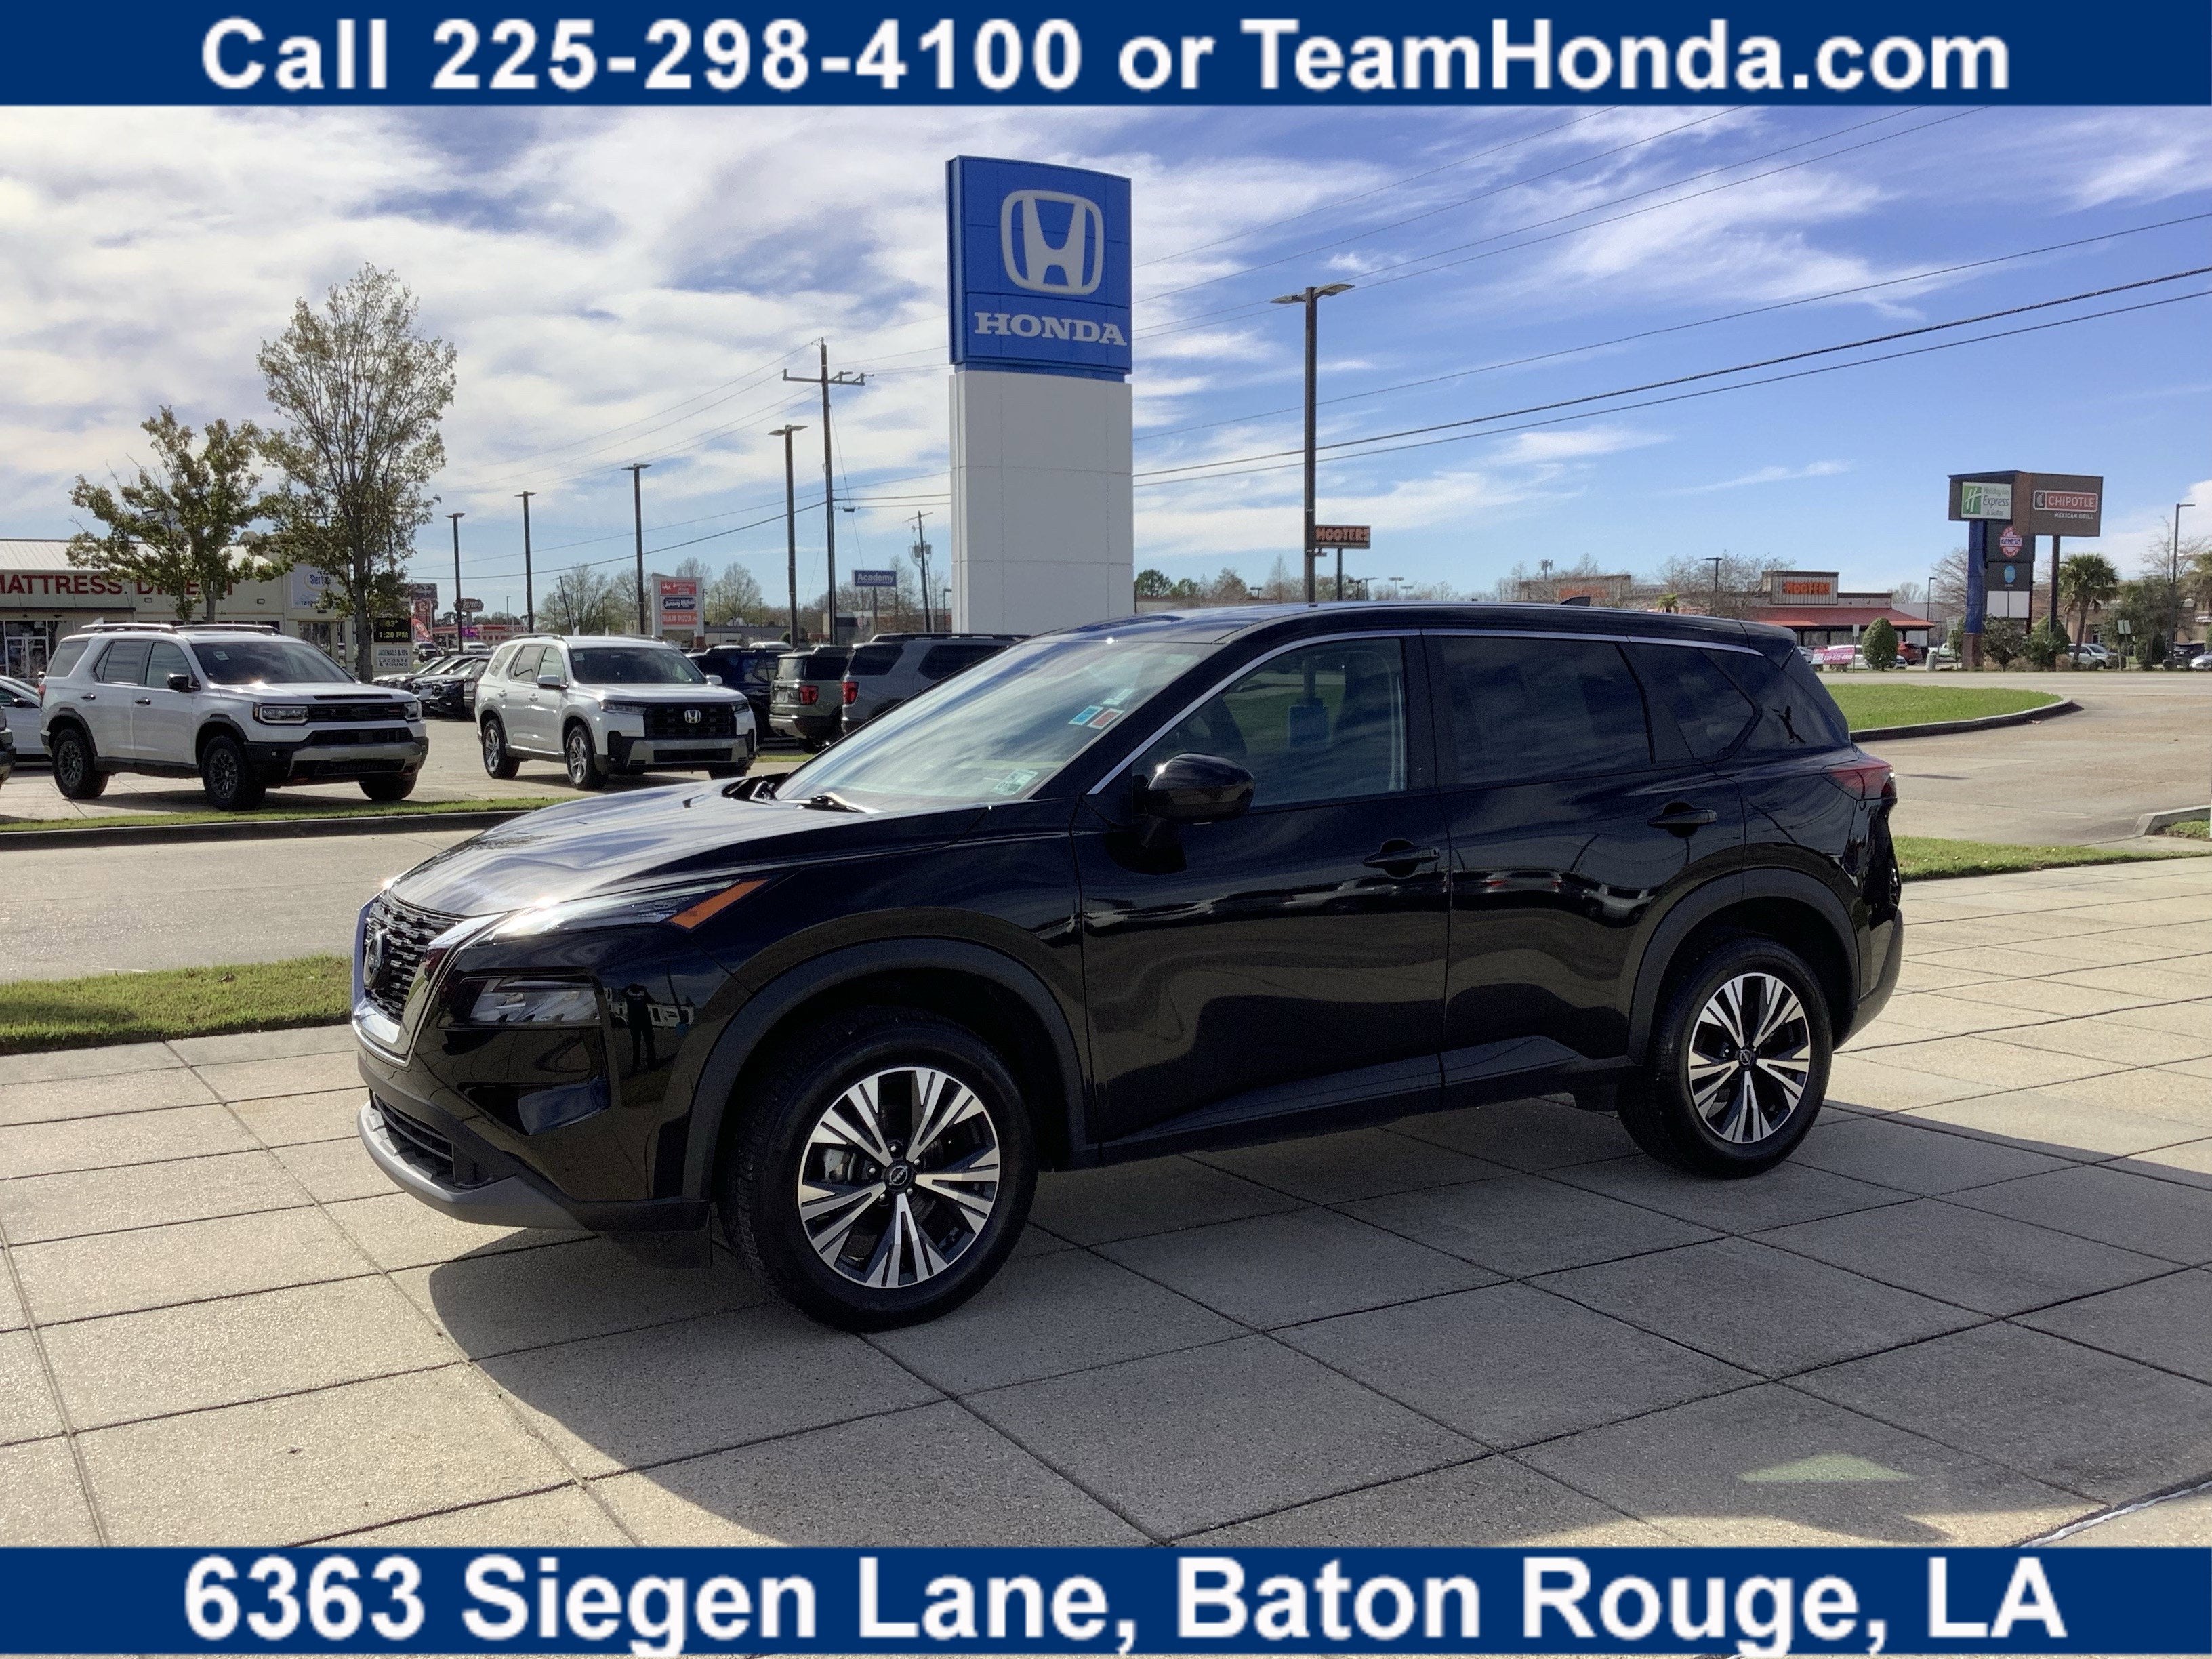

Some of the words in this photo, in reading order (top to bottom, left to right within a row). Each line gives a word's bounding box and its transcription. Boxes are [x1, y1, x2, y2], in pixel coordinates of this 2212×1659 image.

[974, 311, 1128, 347] HONDA
[1983, 495, 2009, 507] Express
[2048, 495, 2095, 508] CHIPOTLE
[1315, 527, 1369, 541] HOOTERS
[857, 573, 894, 583] Academy
[1785, 581, 1830, 595] HOOTERS
